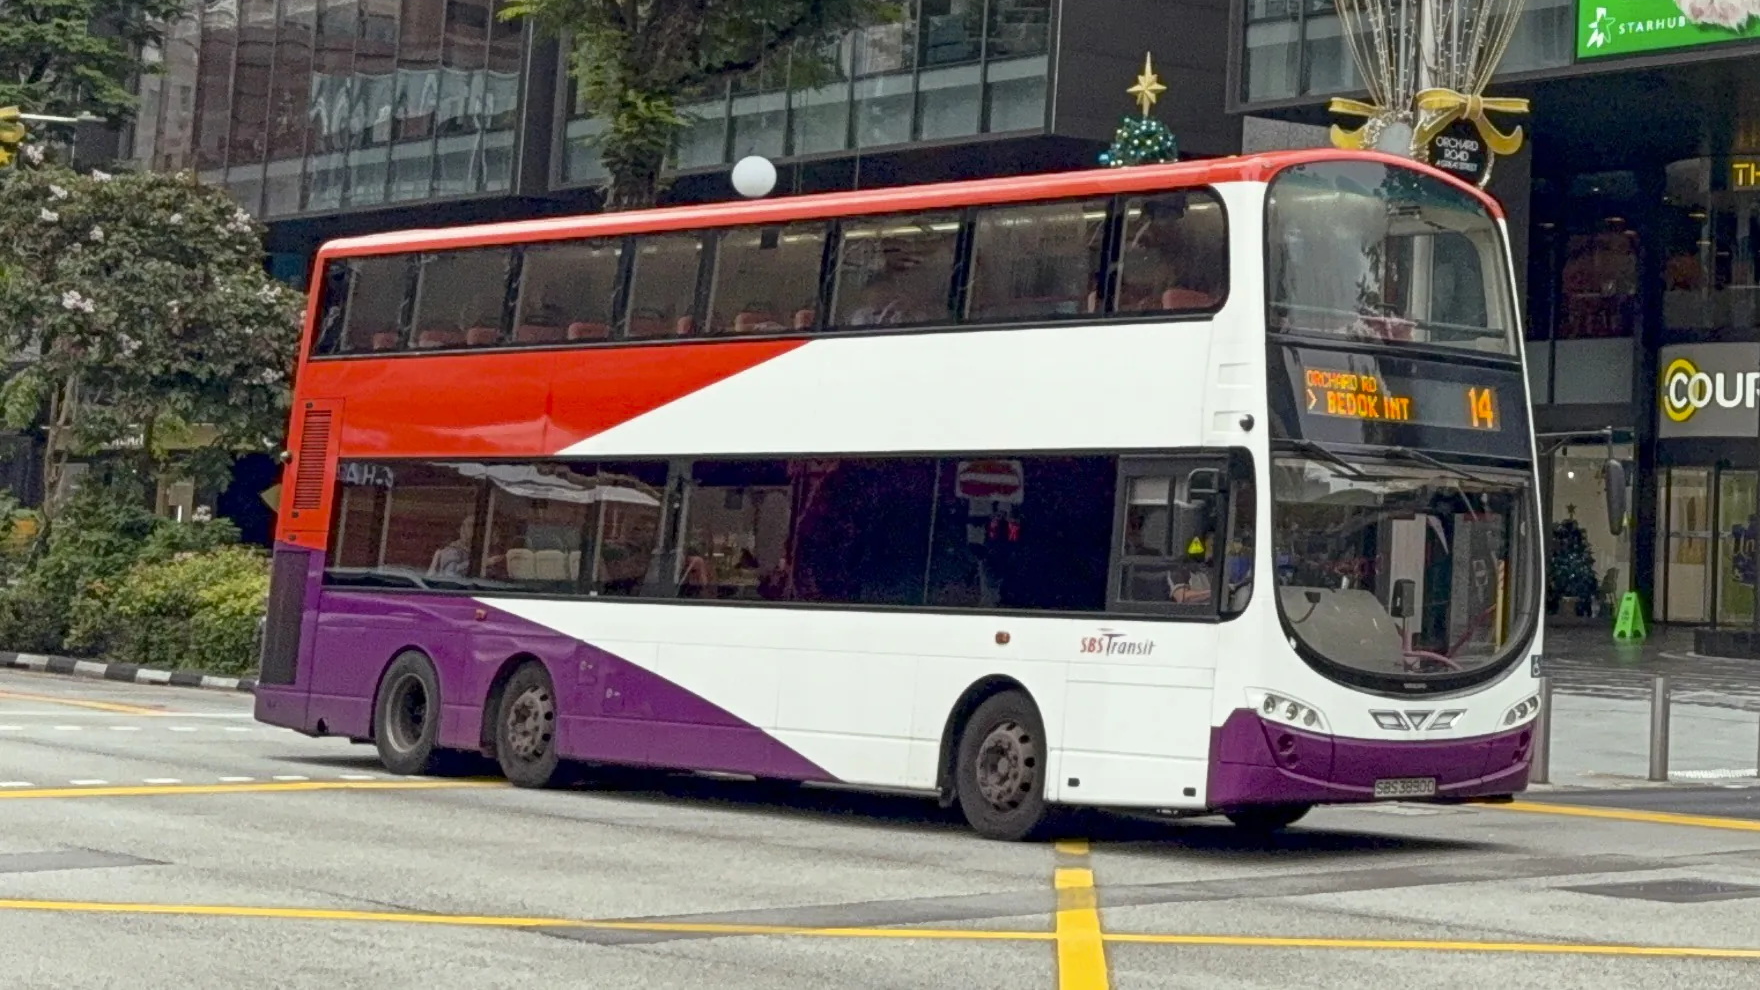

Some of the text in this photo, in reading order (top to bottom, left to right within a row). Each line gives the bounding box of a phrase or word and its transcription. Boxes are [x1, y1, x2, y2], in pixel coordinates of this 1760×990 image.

[1618, 15, 1686, 35] STARHUB
[1435, 136, 1479, 152] ORCHARD
[1443, 148, 1469, 162] ROAD
[1307, 369, 1377, 393] ORCHARD RD
[1326, 390, 1410, 421] BEDOK INT
[1468, 386, 1495, 429] 14
[1080, 632, 1156, 656] SBS Transit
